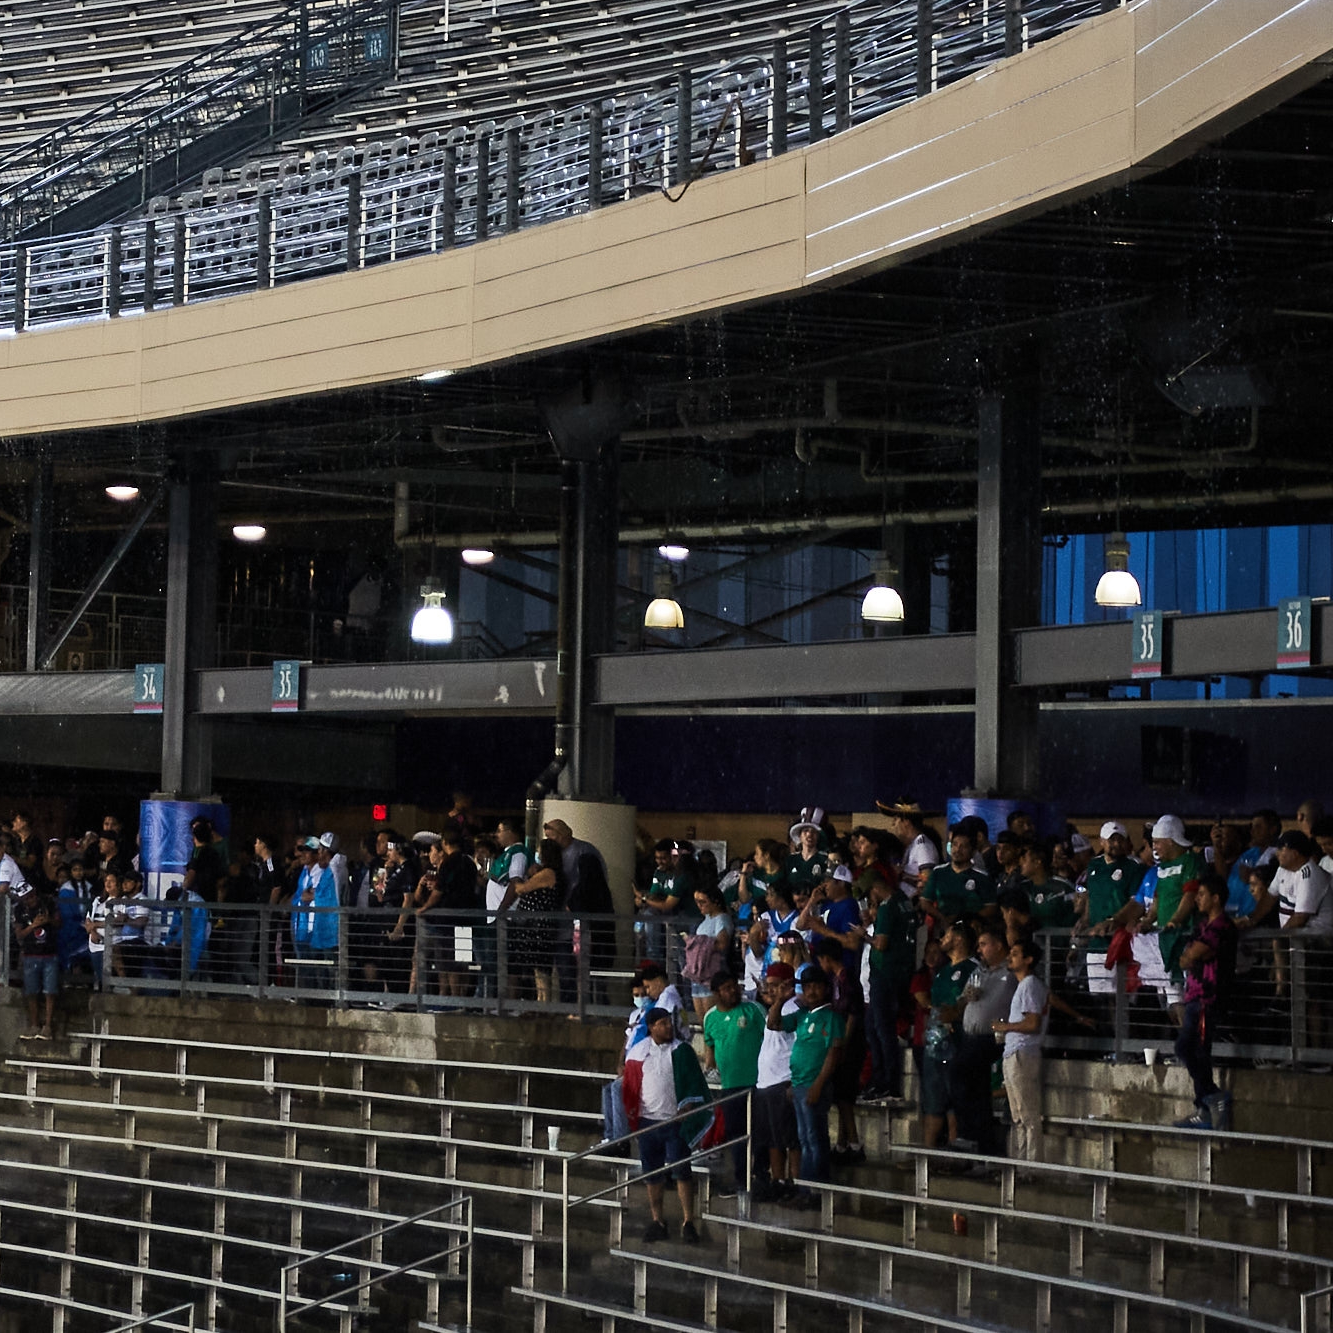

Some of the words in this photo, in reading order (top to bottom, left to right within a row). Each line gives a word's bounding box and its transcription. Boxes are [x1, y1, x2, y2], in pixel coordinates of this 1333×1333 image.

[1140, 623, 1154, 660] 35
[1286, 610, 1302, 650] 36
[142, 673, 156, 700] 34
[279, 670, 291, 698] 35
